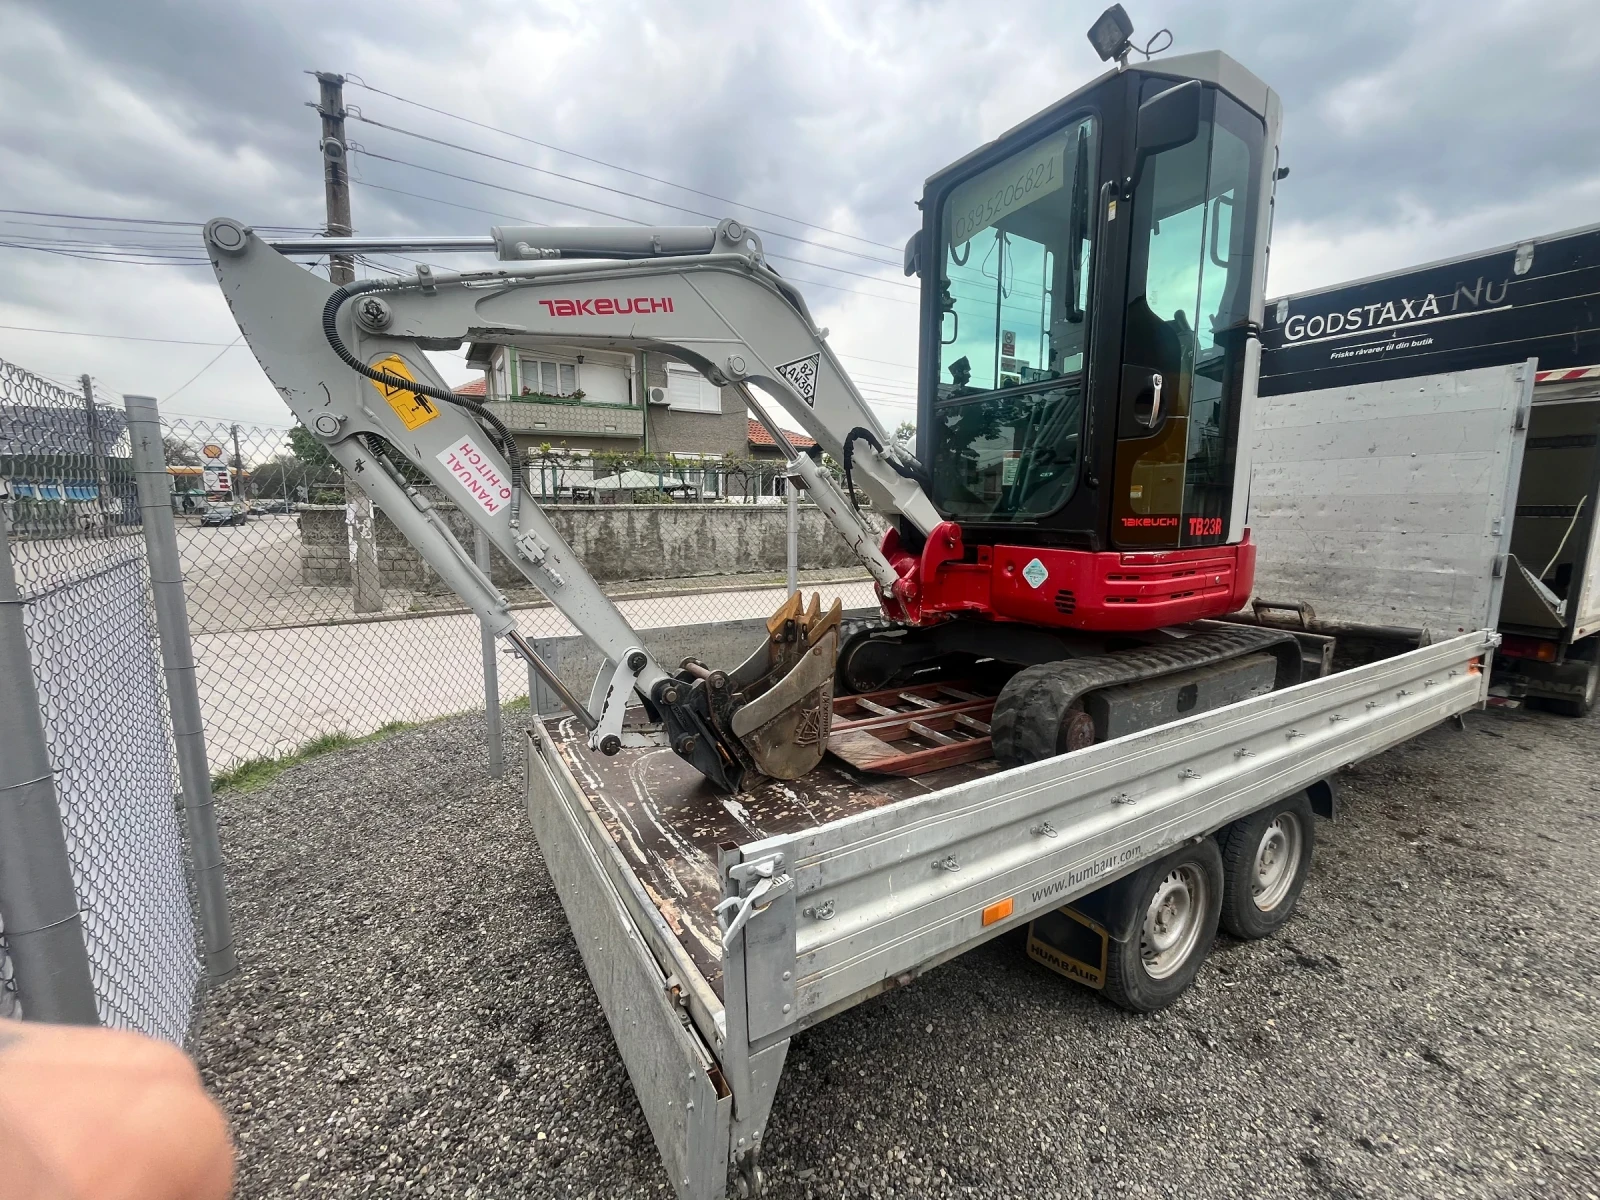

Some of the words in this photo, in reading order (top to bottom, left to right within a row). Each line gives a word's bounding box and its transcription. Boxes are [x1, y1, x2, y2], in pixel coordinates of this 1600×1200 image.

[956, 157, 1055, 239] 0895206821
[538, 297, 674, 316] TAKEUCHI
[1284, 294, 1439, 340] GODSTAXA
[1330, 351, 1354, 360] Friske
[1355, 346, 1384, 356] råvarer
[1385, 343, 1394, 351] til
[1395, 341, 1410, 349] din
[1410, 338, 1434, 347] butik
[787, 367, 813, 395] AW3G
[800, 363, 814, 380] 82
[446, 453, 499, 512] MANUAL
[459, 443, 511, 499] Q-HITCH
[1121, 518, 1178, 527] TAKEUCHI
[1189, 517, 1222, 535] TB23R
[1031, 845, 1141, 903] www.humbaur.com
[1031, 943, 1099, 983] HUMBAUR
